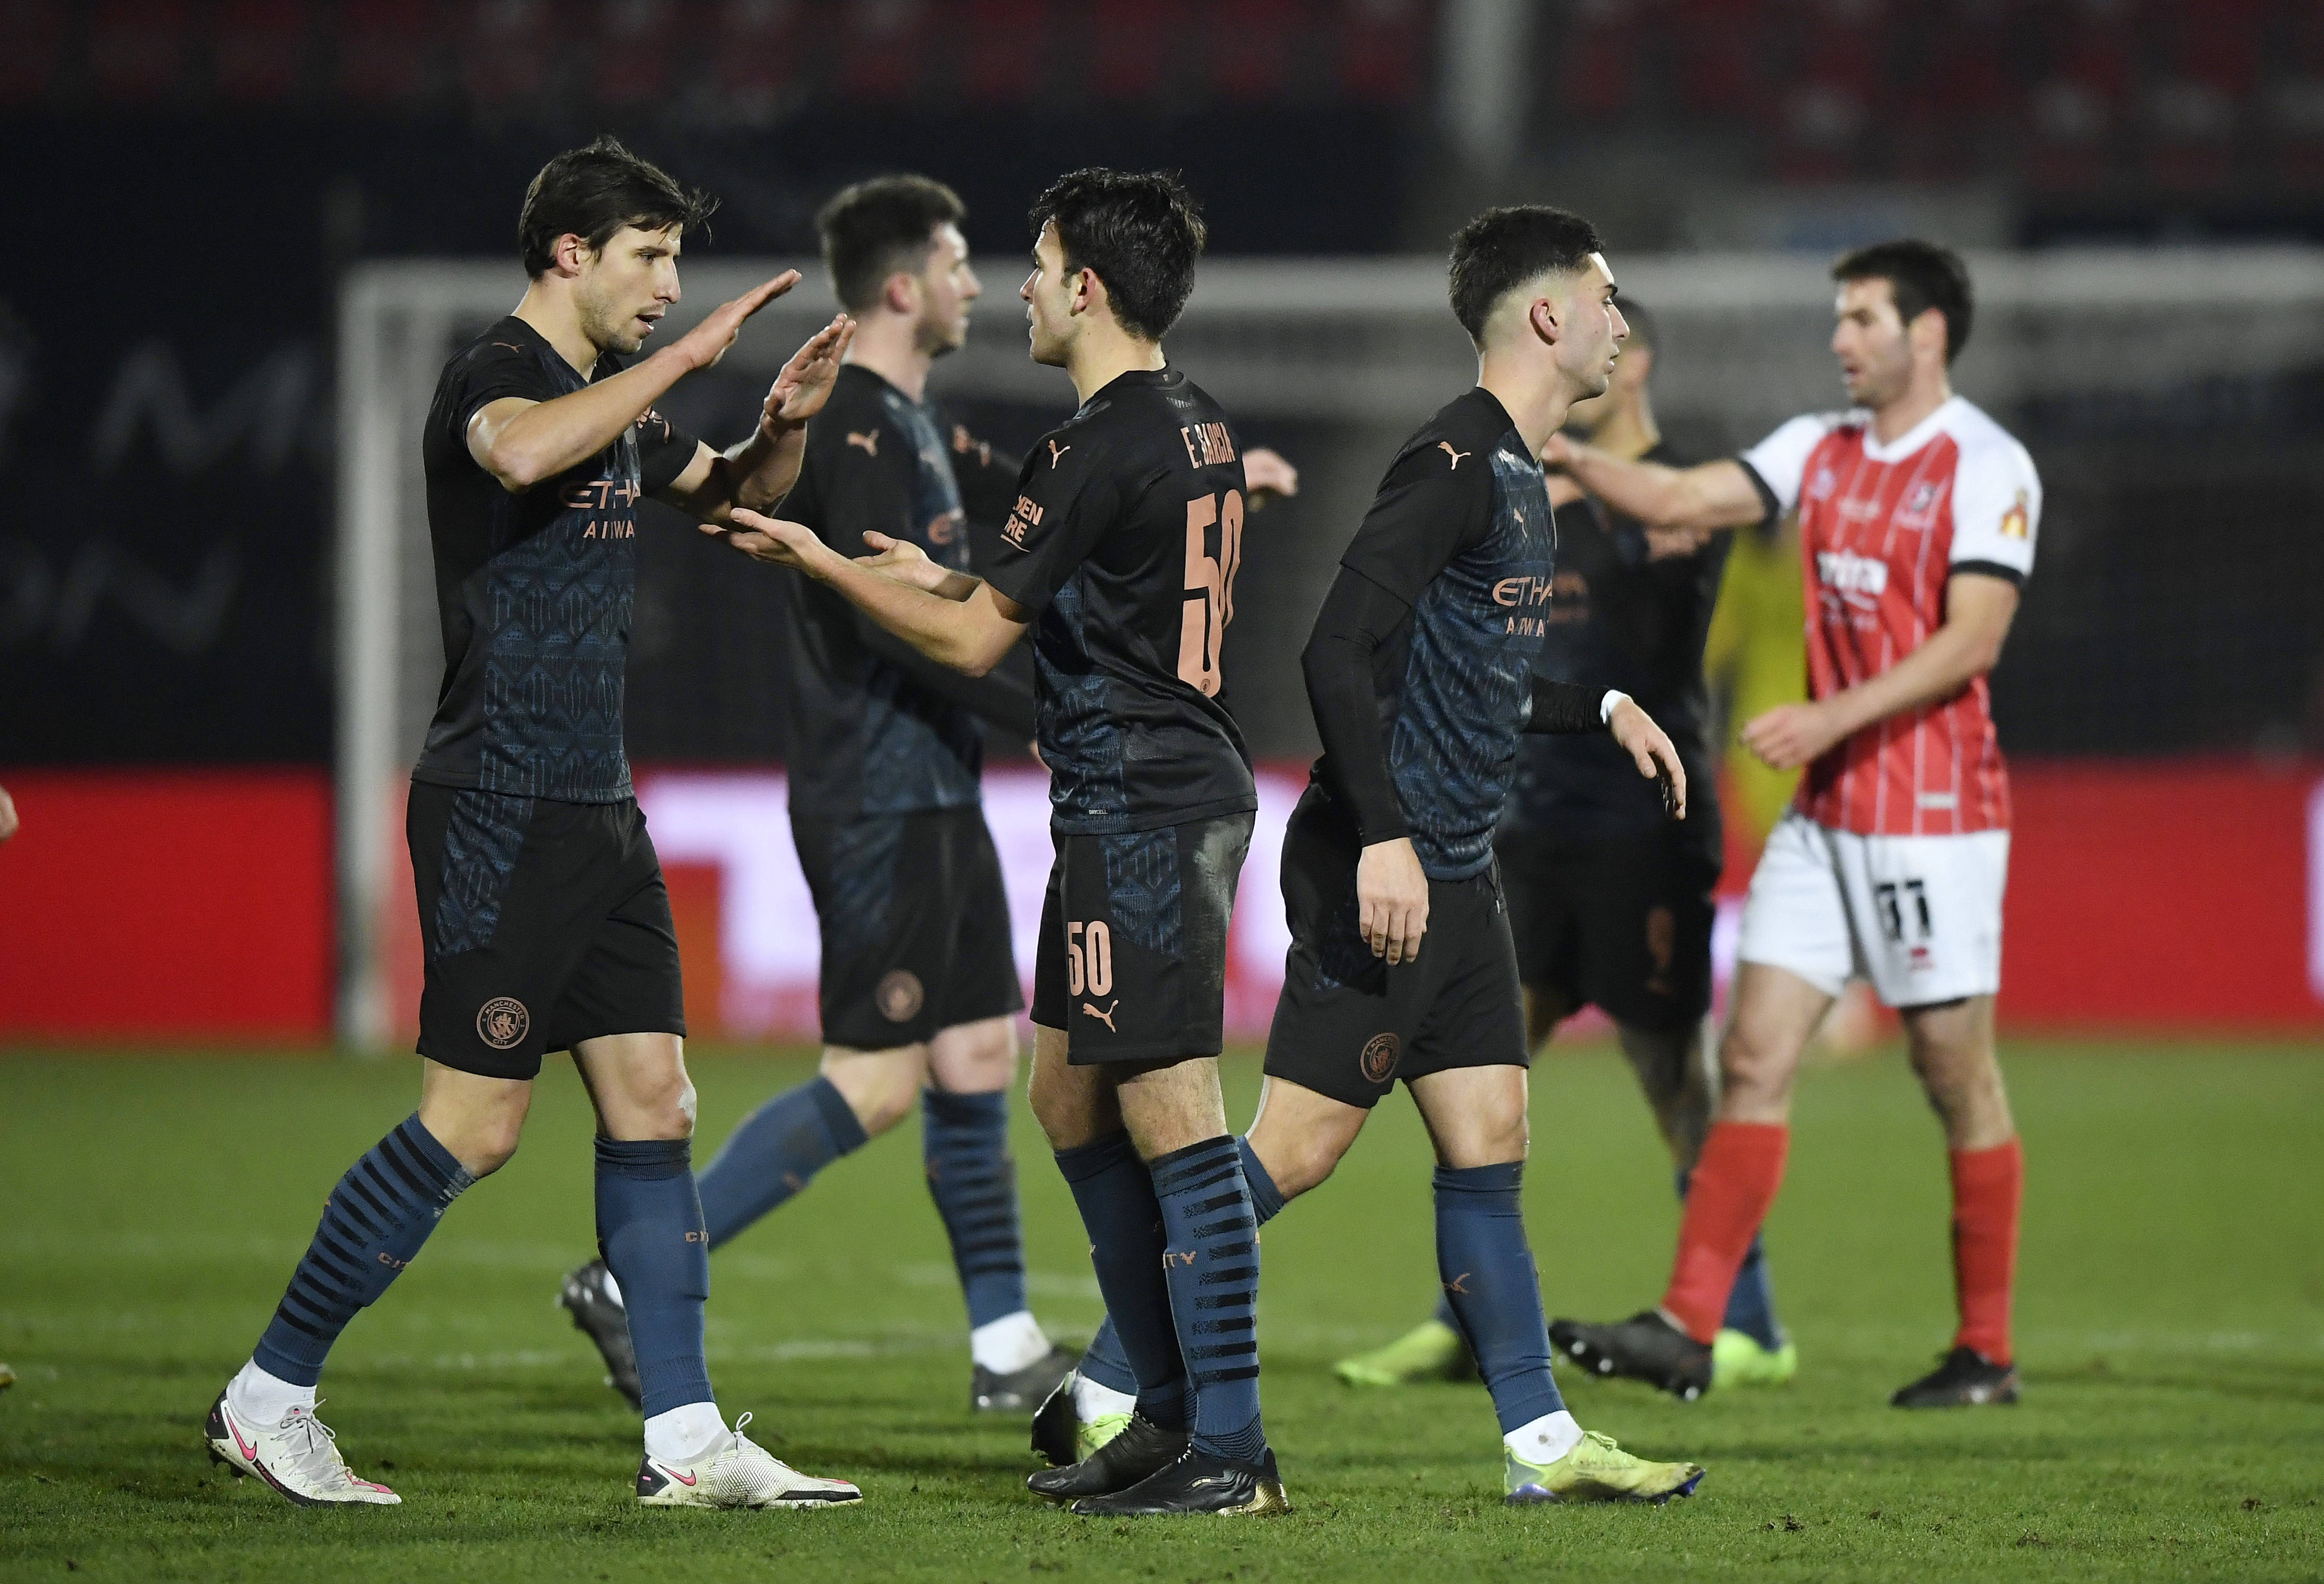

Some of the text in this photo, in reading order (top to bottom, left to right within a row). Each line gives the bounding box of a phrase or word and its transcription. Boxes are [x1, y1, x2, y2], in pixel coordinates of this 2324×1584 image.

[1178, 489, 1244, 699] 50
[1068, 920, 1112, 996] 50
[485, 1001, 525, 1019] MANCHESTER
[1163, 1251, 1196, 1269] ITY
